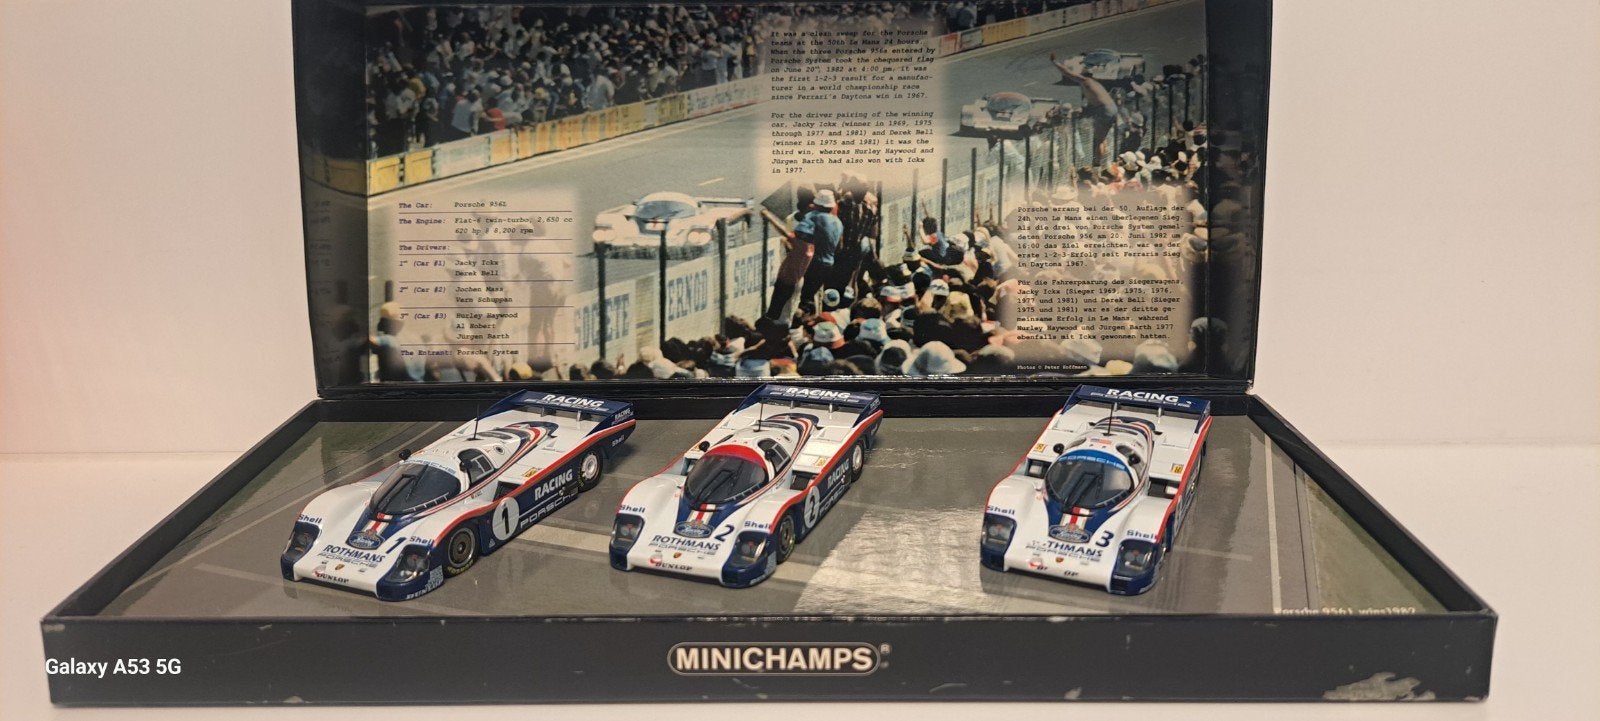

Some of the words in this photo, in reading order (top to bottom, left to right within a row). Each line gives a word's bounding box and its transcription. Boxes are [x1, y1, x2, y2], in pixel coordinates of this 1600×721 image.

[786, 388, 851, 399] RACING
[1106, 388, 1179, 402] RACING
[542, 394, 604, 408] RACING
[1059, 455, 1126, 470] PORSCHE
[828, 458, 850, 489] RACING
[534, 468, 573, 502] RACING
[620, 505, 646, 514] Shell
[987, 506, 1015, 516] Shell
[298, 514, 322, 524] Shell
[502, 506, 510, 535] 1
[744, 520, 772, 530] Shell
[715, 524, 735, 542] 2
[1096, 530, 1114, 548] 3
[1126, 530, 1157, 540] Shell
[386, 536, 407, 554] 1
[410, 536, 432, 545] Shell
[652, 534, 720, 551] ROTHMANS
[323, 544, 386, 563] ROTHMANS
[648, 542, 717, 556] PORSCHE
[1032, 540, 1104, 558] THMANS
[318, 552, 378, 568] PORSCHE
[655, 562, 693, 571] DUNLOP
[317, 572, 349, 584] DUNLOP
[676, 647, 874, 671] MINICHAMPS
